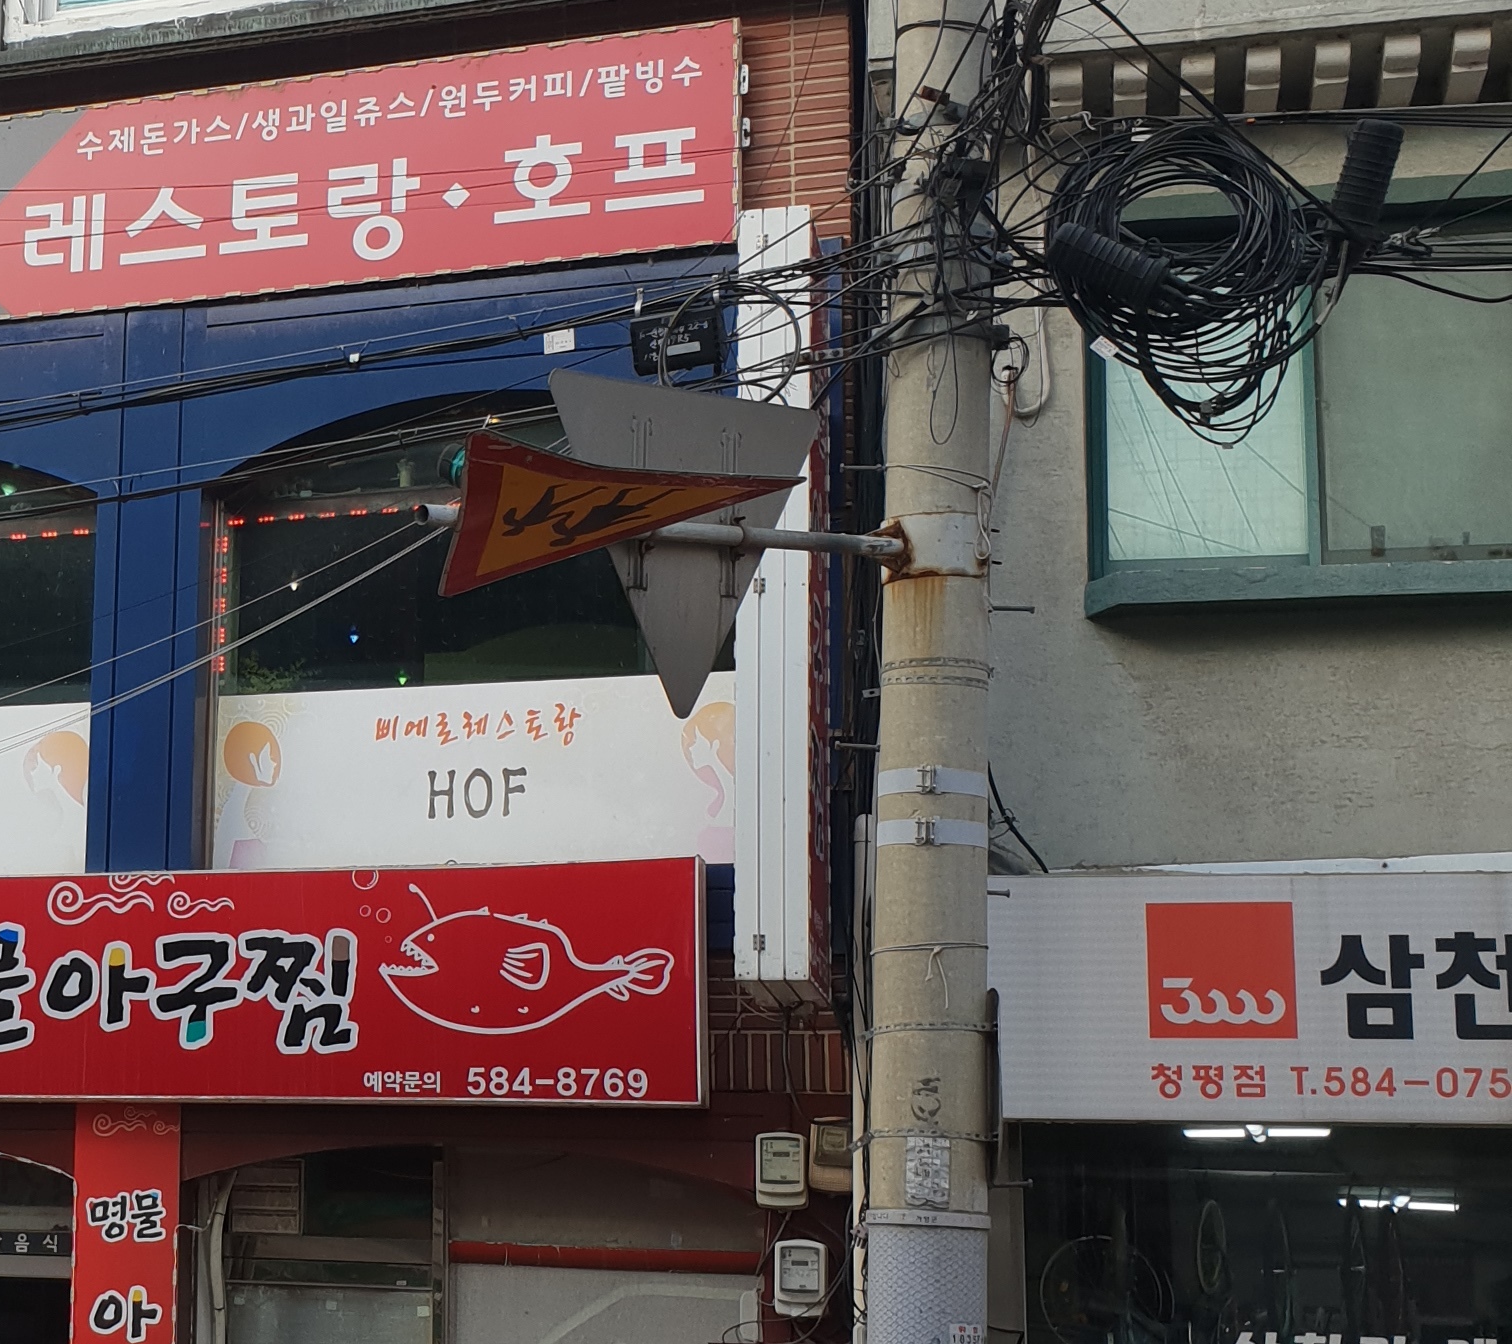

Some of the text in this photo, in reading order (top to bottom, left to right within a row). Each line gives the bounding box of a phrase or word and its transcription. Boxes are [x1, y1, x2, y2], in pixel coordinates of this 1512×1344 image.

[428, 767, 527, 819] HOF
[363, 1066, 648, 1097] 예약문의 584-8769
[1150, 1064, 1267, 1099] 청평점
[89, 1189, 166, 1242] 명물
